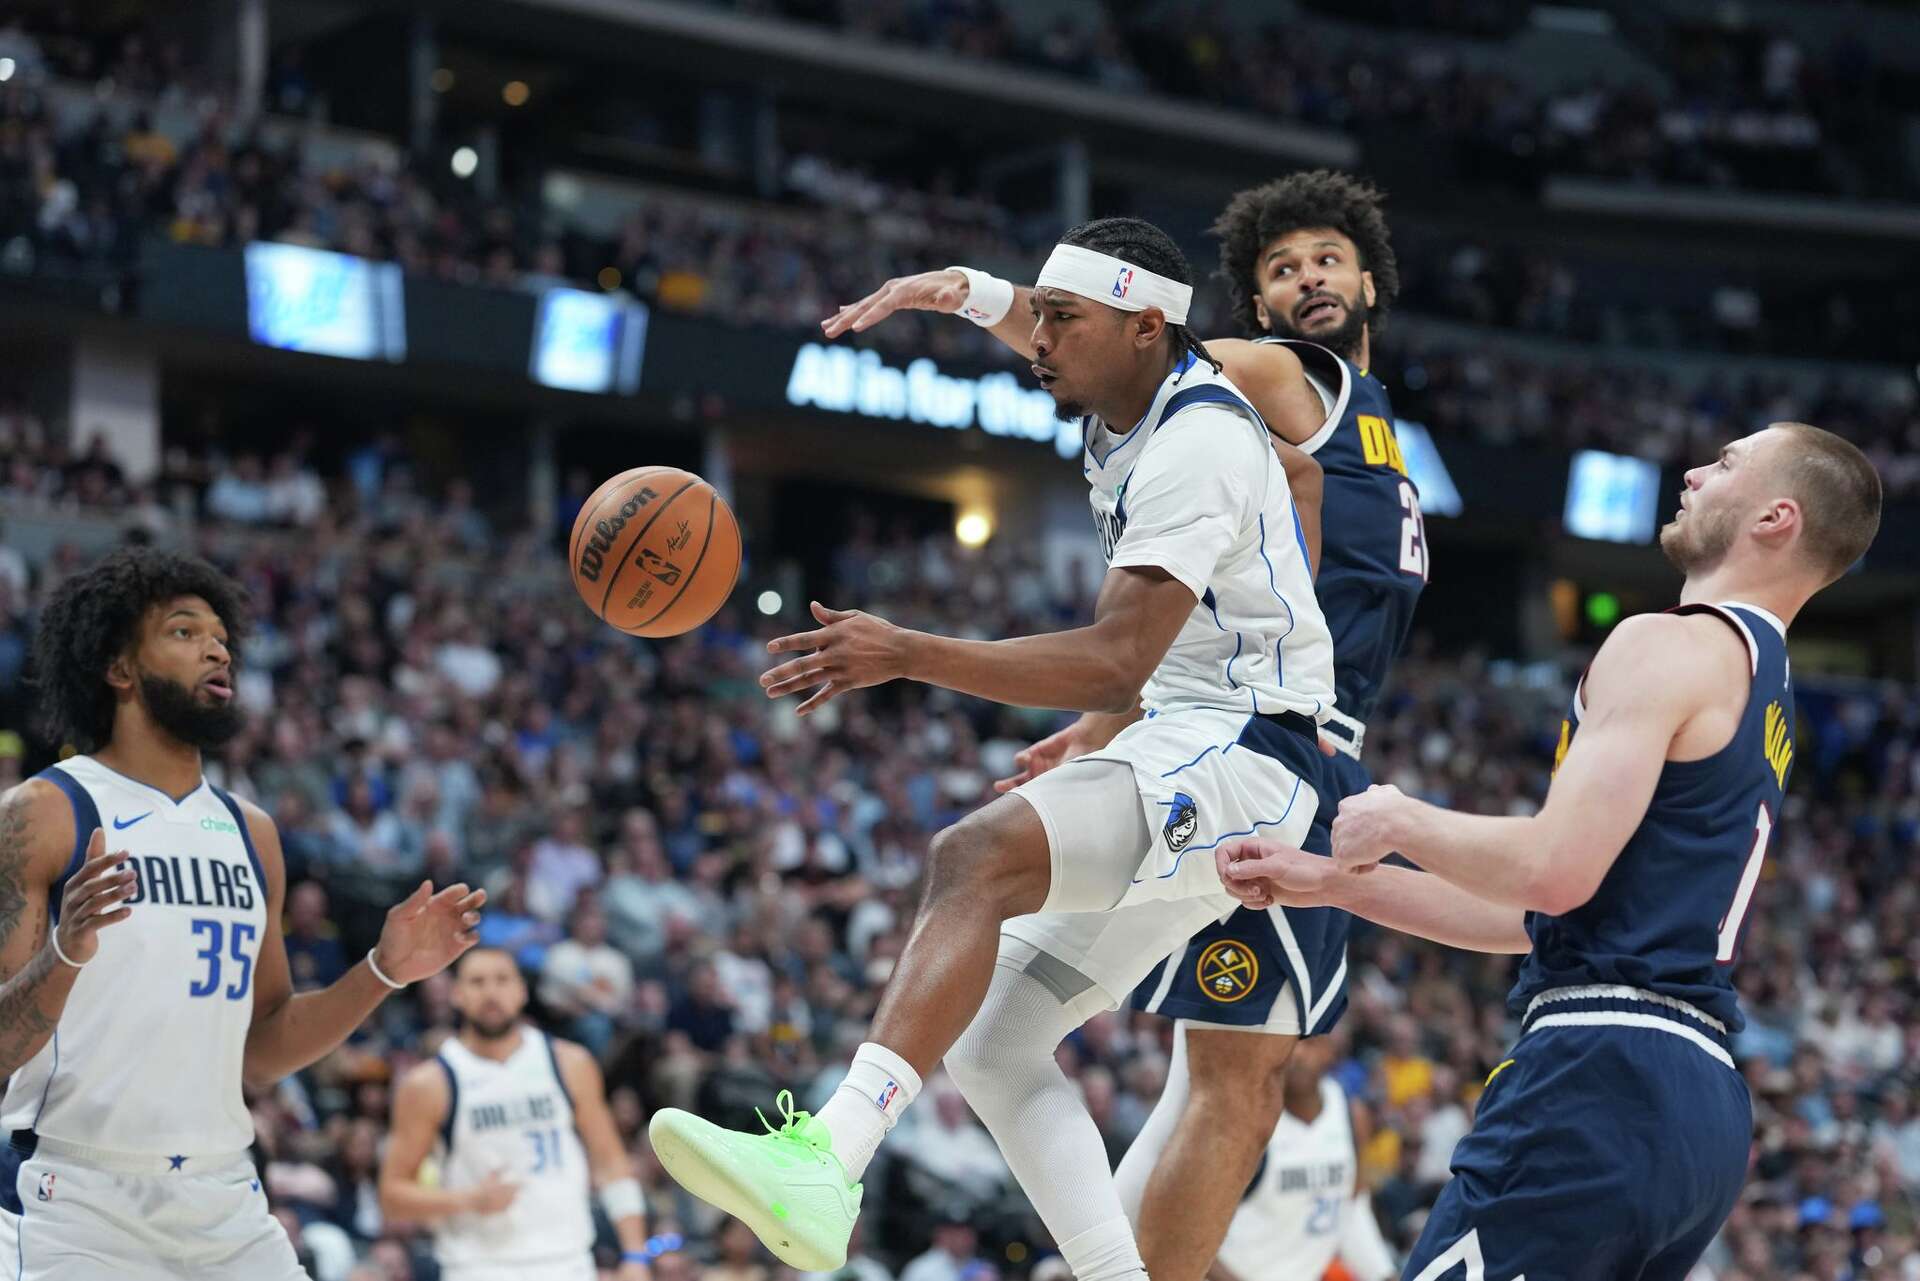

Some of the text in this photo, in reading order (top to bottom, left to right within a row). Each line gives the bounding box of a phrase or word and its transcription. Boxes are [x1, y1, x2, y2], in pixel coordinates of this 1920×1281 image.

[787, 343, 854, 412] All
[856, 349, 905, 420] in
[907, 358, 976, 429] for
[580, 487, 658, 583] Wilson
[201, 816, 239, 834] chime
[116, 856, 254, 910] DALLAS
[189, 919, 256, 1000] 35
